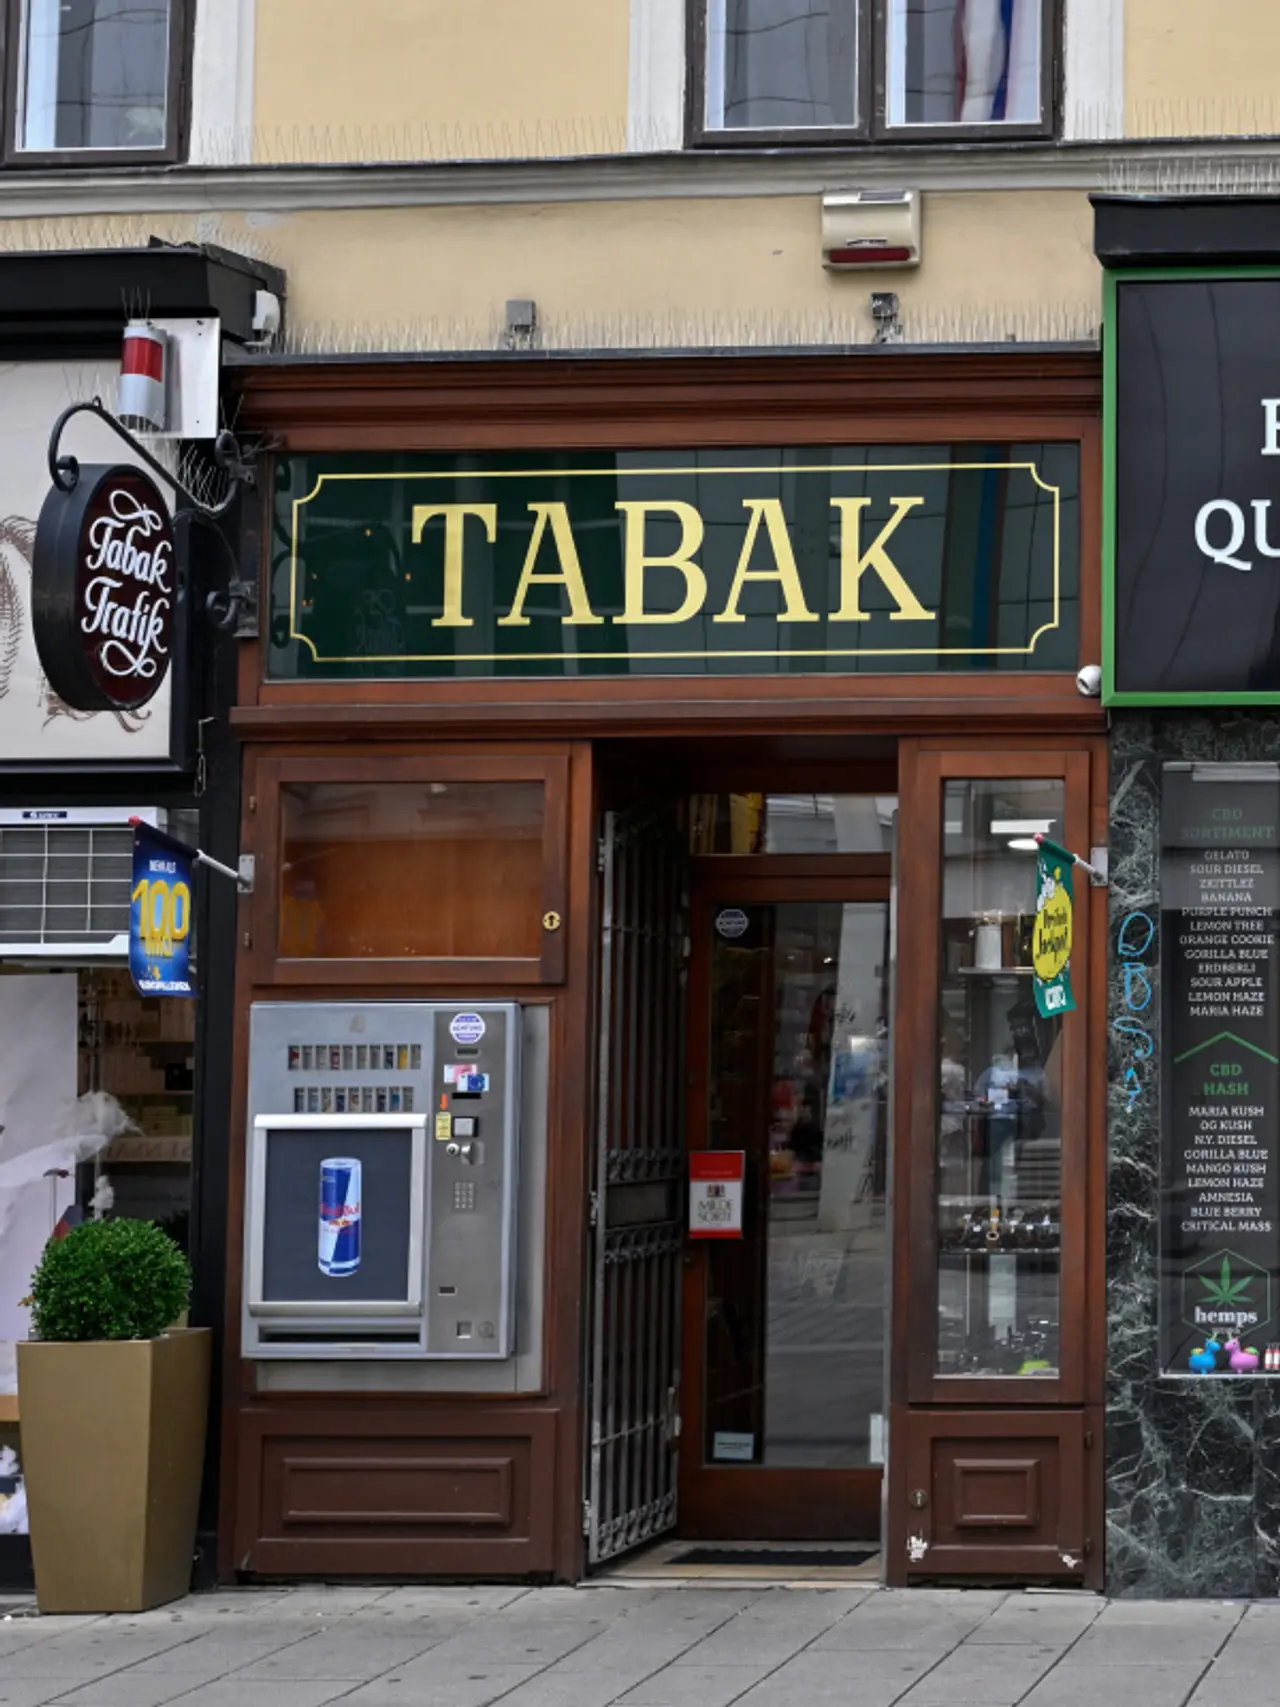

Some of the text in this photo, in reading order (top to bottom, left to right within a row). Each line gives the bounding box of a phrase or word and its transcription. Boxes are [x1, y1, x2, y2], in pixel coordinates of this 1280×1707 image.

[86, 514, 172, 594] Tabak
[411, 496, 936, 627] TABAK
[1211, 808, 1243, 820] CBD
[1204, 850, 1250, 860] GELATO
[1190, 864, 1264, 875] SOUR DIESEL
[1200, 892, 1253, 903] BANANA
[131, 879, 191, 941] 100
[1181, 906, 1273, 917] PURPLE PUNCH
[1190, 920, 1264, 931] LEMON TREE
[1179, 934, 1275, 945] ORANGE COOKIE
[1184, 949, 1268, 960] GORILLA BLUE
[1190, 977, 1263, 988] SOUR APPLE
[1188, 991, 1265, 1002] LEMON HAZE
[1189, 1006, 1264, 1017] MARIA HAZE
[1209, 1064, 1243, 1077] CBD
[1203, 1082, 1249, 1096] HASH
[1188, 1106, 1265, 1117] MARIA KUSH
[1200, 1120, 1253, 1131] OG KUSH
[1217, 1135, 1258, 1145] DIESEL
[1184, 1149, 1269, 1160] GORILLA BLUE
[1186, 1163, 1266, 1175] MANGO KUSH
[1187, 1178, 1265, 1189] LEMON HAZE
[1198, 1192, 1254, 1203] AMNESIA
[1190, 1207, 1262, 1218] BLUE BERRY
[1181, 1221, 1272, 1232] CRITICAL MASS
[1194, 1306, 1258, 1327] hemps
